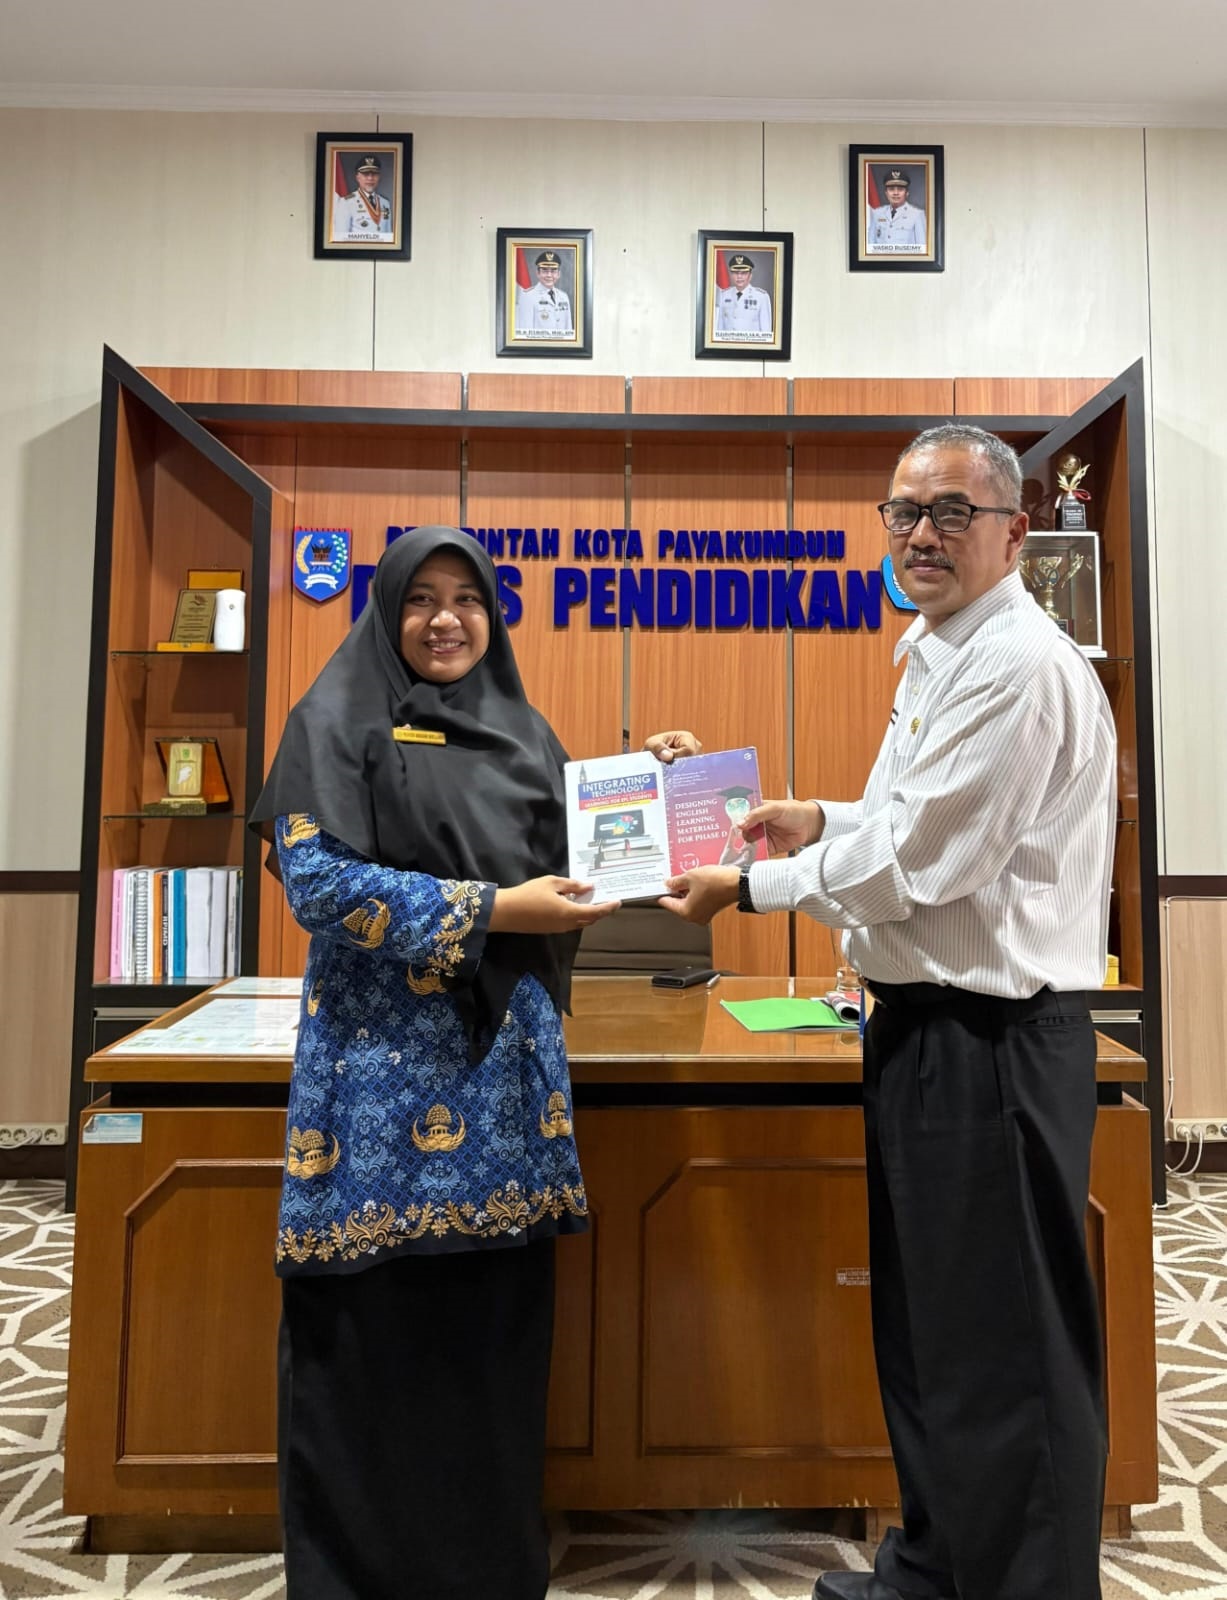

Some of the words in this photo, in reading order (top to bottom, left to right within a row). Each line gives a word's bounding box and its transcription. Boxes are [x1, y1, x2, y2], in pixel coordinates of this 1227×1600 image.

[574, 529, 644, 558] KOTA
[658, 529, 845, 560] PAYAKUMBUH
[553, 567, 882, 629] PENDIDIKAN
[582, 774, 651, 793] INTEGRATING
[592, 784, 645, 798] TECHNOLOGY
[674, 798, 718, 810] DESIGNING
[676, 807, 709, 818] ENGLISH
[677, 815, 716, 827] LEARNING
[677, 823, 720, 835] MATERIALS
[678, 835, 694, 844] FOR
[695, 831, 720, 841] PHASE
[721, 830, 728, 838] D
